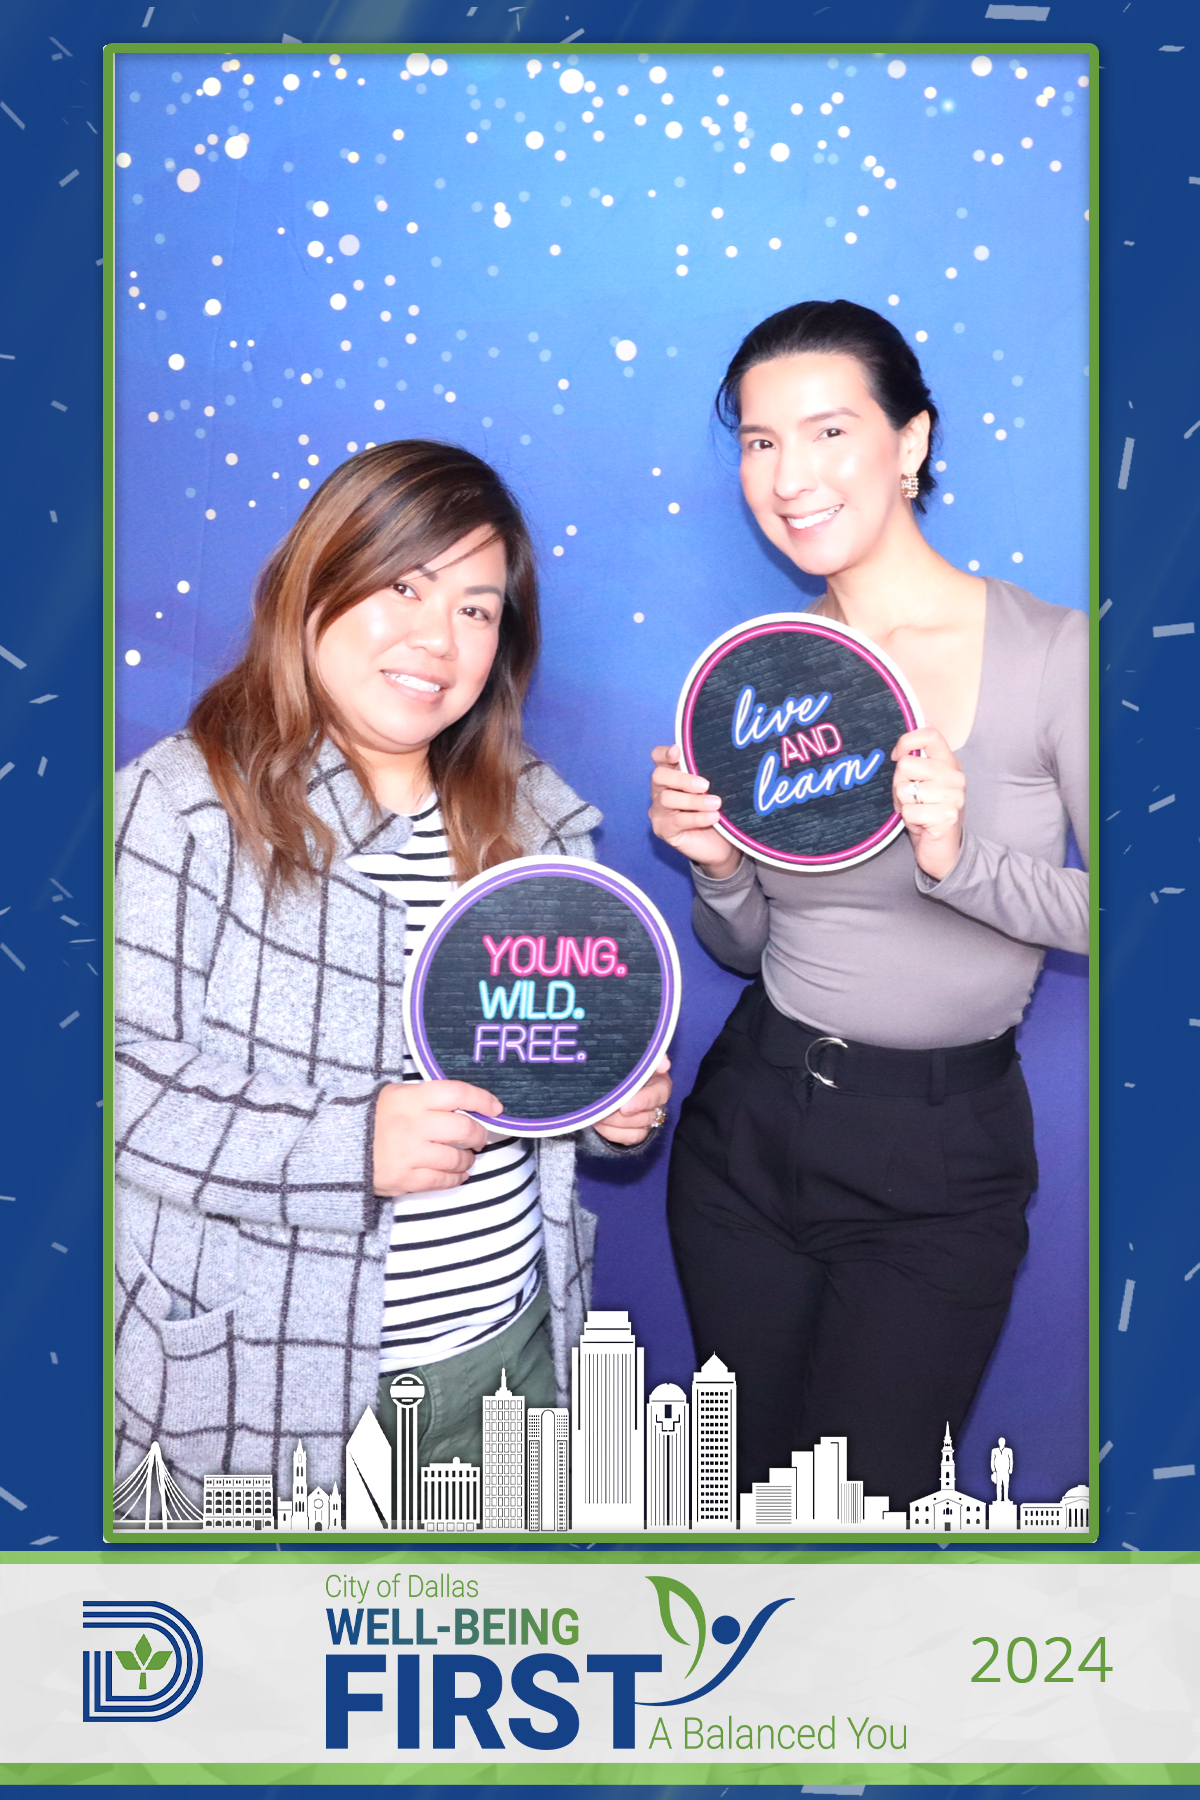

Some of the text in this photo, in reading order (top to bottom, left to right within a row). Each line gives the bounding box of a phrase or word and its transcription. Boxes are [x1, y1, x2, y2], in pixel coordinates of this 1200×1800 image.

[733, 686, 831, 748] live
[781, 723, 842, 768] AND
[755, 751, 884, 815] learn
[482, 935, 628, 977] YOUNG.
[478, 980, 586, 1020] WILD.
[473, 1023, 587, 1063] FREE.
